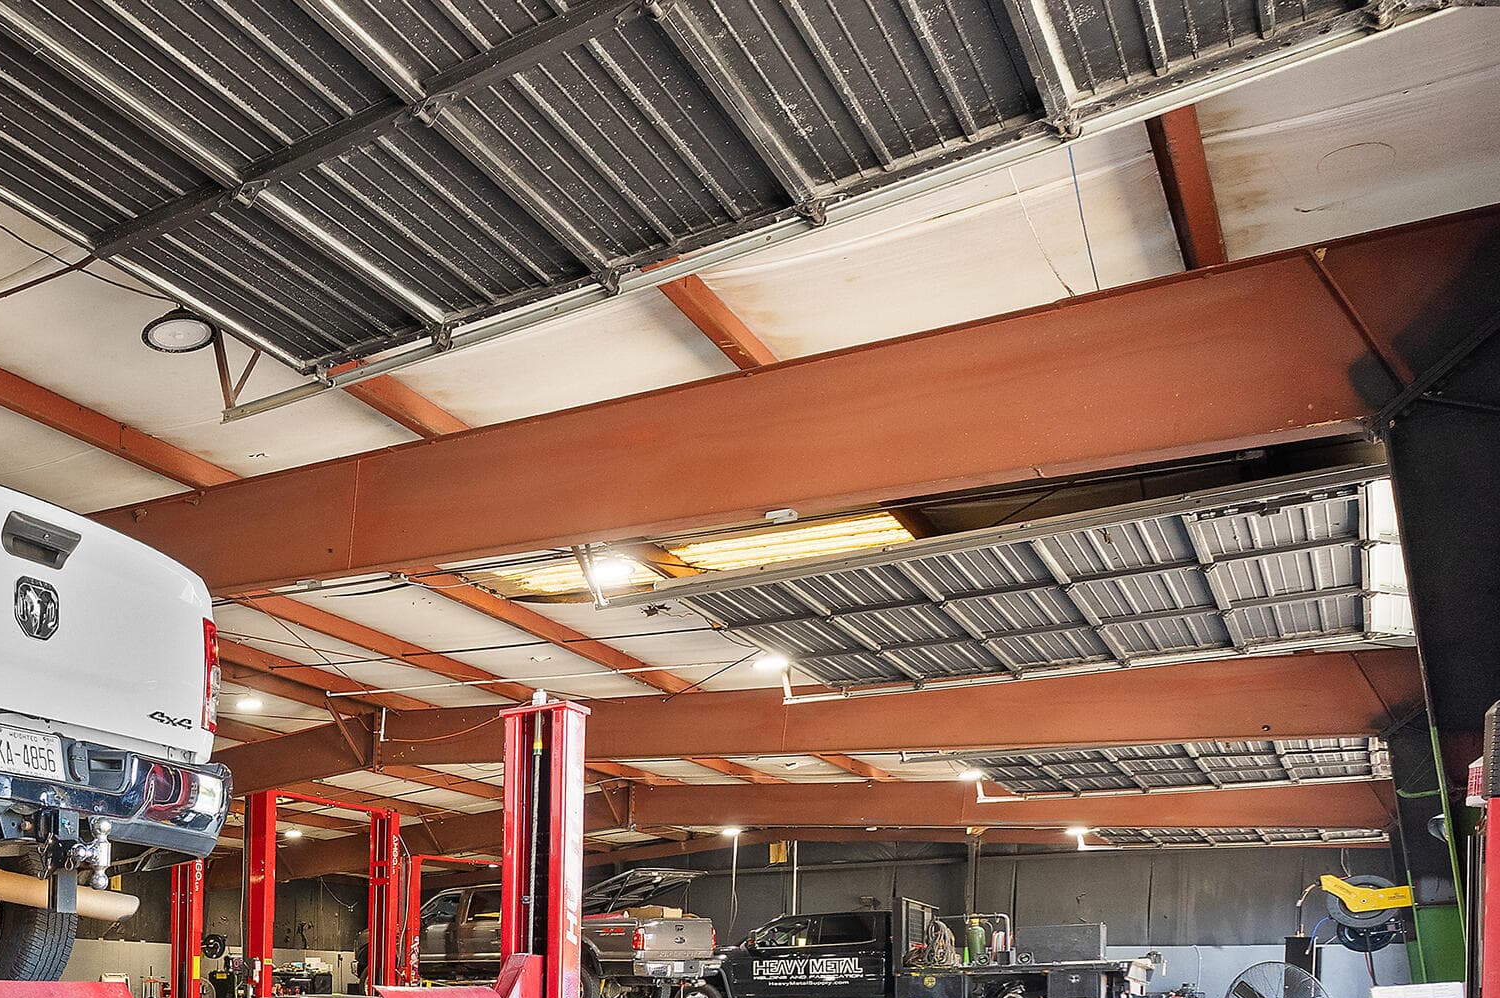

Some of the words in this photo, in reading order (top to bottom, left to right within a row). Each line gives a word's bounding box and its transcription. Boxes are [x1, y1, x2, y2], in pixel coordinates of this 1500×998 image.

[148, 711, 192, 730] 4x4
[753, 959, 809, 975] HEAVY
[809, 957, 863, 974] METAL
